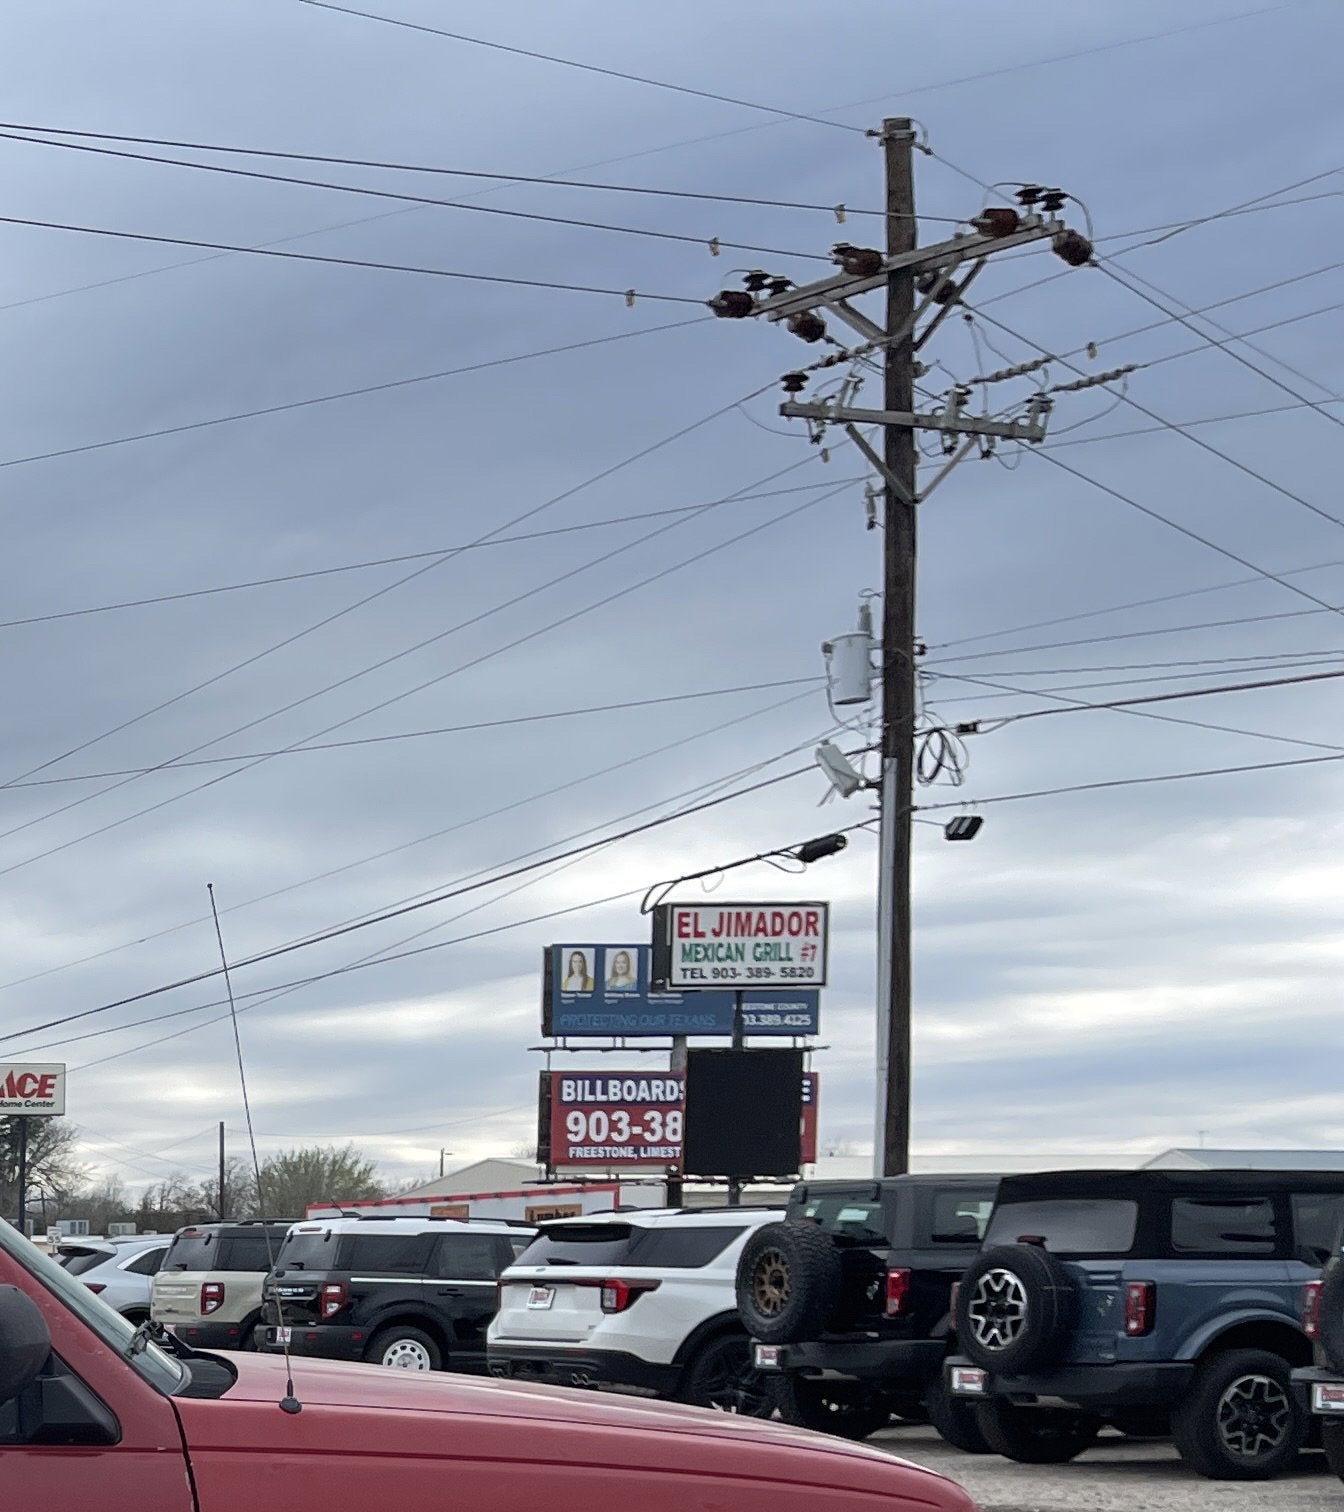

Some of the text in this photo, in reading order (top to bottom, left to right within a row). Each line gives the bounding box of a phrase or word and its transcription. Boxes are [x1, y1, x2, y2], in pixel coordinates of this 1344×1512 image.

[677, 911, 819, 938] EL JIMADOR
[681, 943, 745, 963] MEXICAN
[753, 942, 793, 962] GRILL
[680, 967, 707, 979] TEL
[712, 967, 741, 979] 903-
[568, 1146, 638, 1159] FREESTONE,
